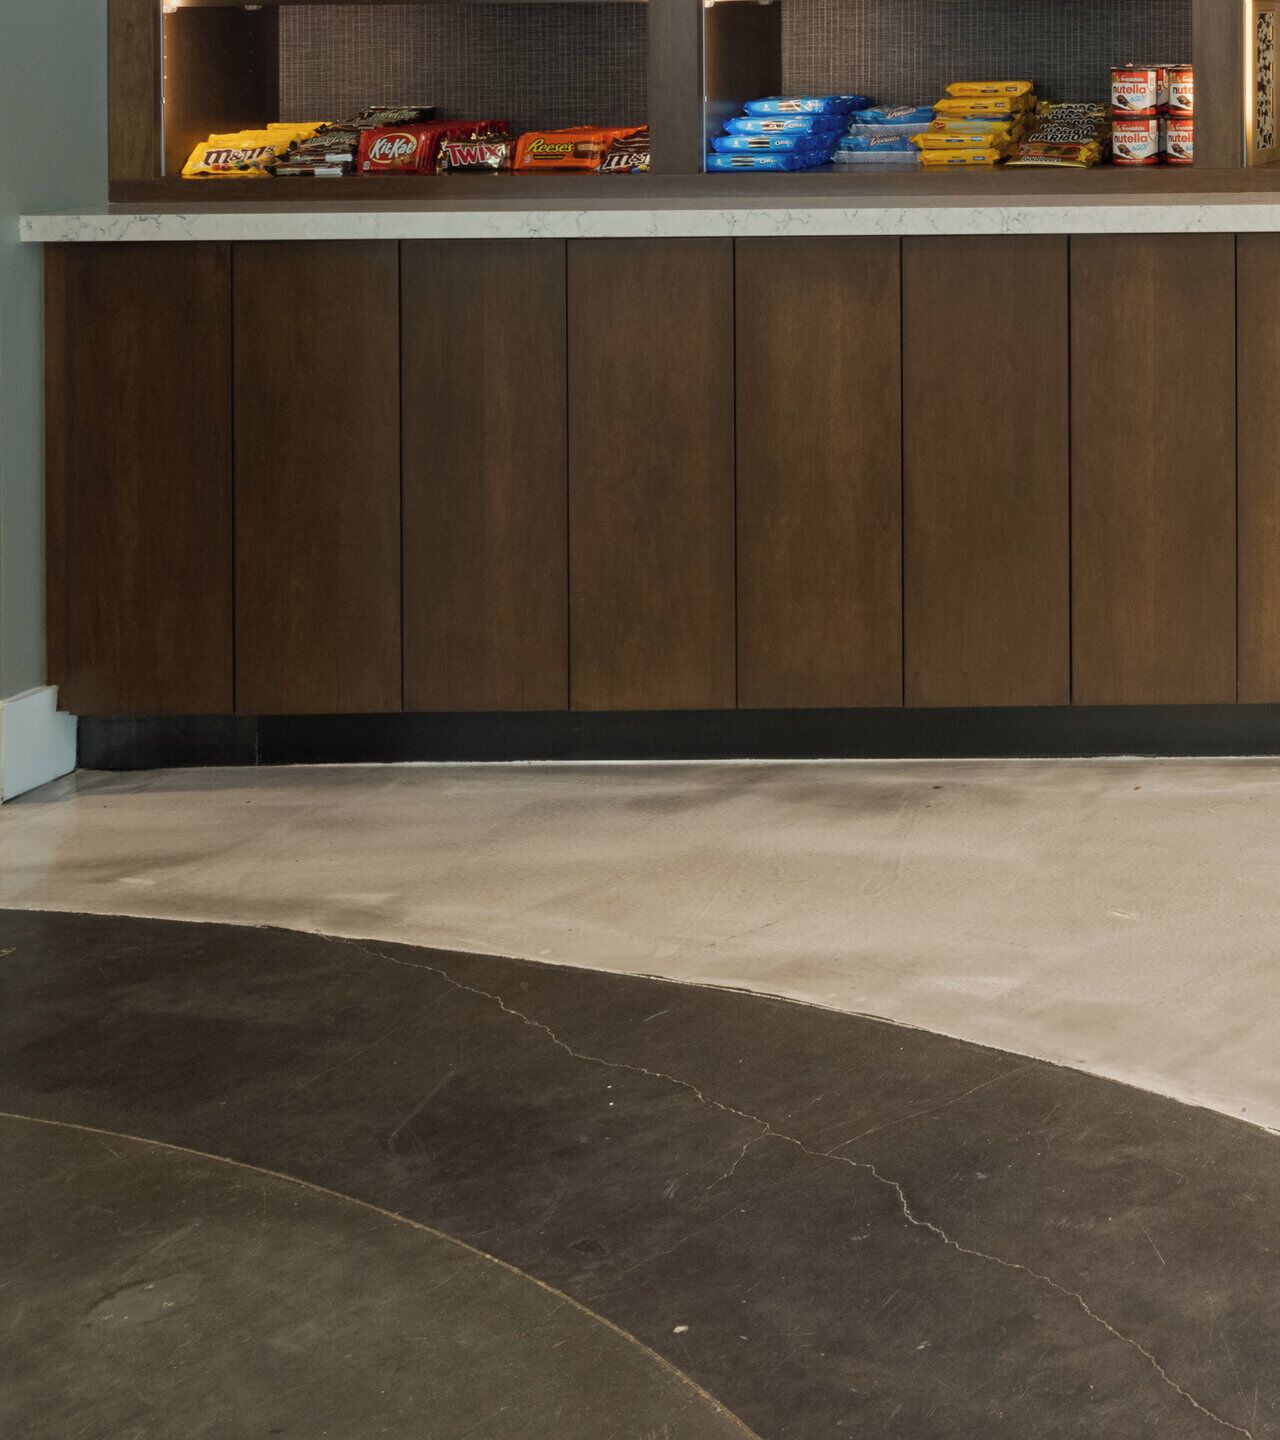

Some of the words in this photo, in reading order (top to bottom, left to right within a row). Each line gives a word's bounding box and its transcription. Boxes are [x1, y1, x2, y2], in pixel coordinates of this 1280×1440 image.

[1113, 84, 1147, 95] nutella
[1028, 132, 1082, 142] HARIBO
[1114, 133, 1148, 143] nutella
[527, 138, 574, 155] Reese's
[446, 142, 505, 167] Twix
